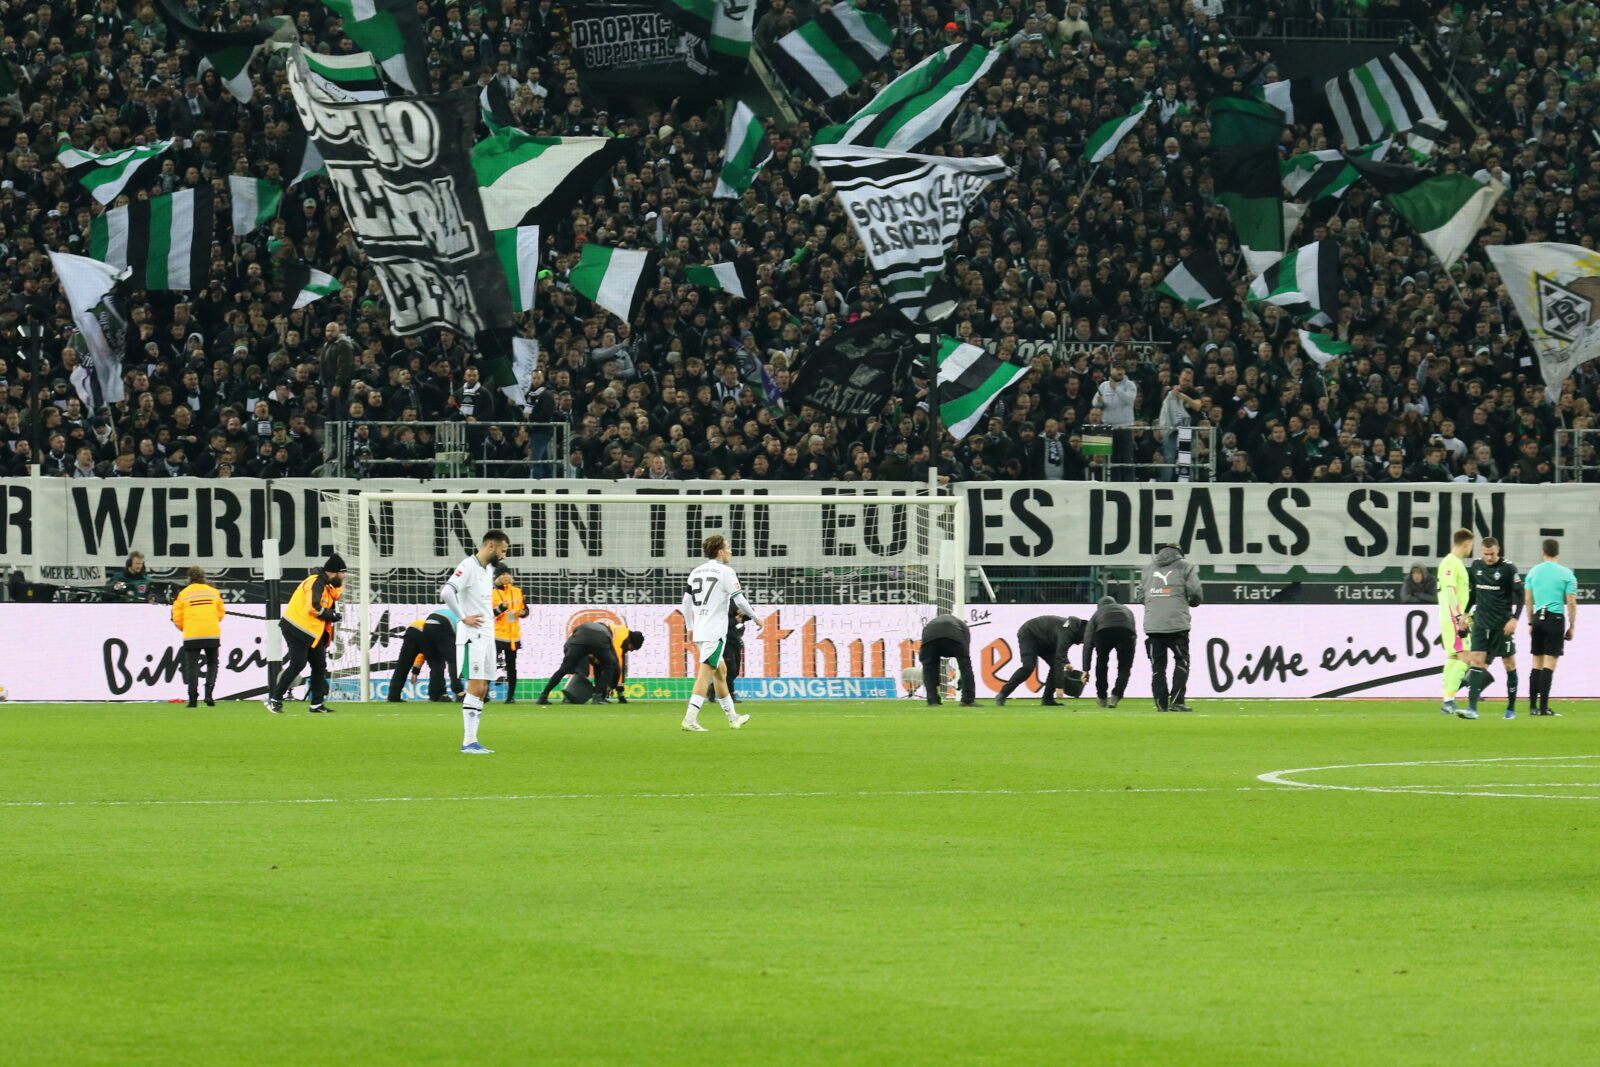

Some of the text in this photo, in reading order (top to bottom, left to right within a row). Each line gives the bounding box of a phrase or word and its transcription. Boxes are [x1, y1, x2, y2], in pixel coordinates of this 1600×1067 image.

[572, 13, 673, 48] DROPKIC
[585, 37, 677, 68] SUPPORTERS
[71, 486, 395, 559] WERDEN
[432, 488, 603, 558] KEIN
[635, 488, 788, 558] TEIL
[1088, 487, 1312, 556] DEALS
[1344, 488, 1506, 559] SEIN
[692, 576, 719, 607] 27
[1232, 585, 1282, 600] flat
[1334, 585, 1395, 600] flatex
[1206, 636, 1397, 693] Bitte ein
[754, 679, 862, 698] JONGEN
